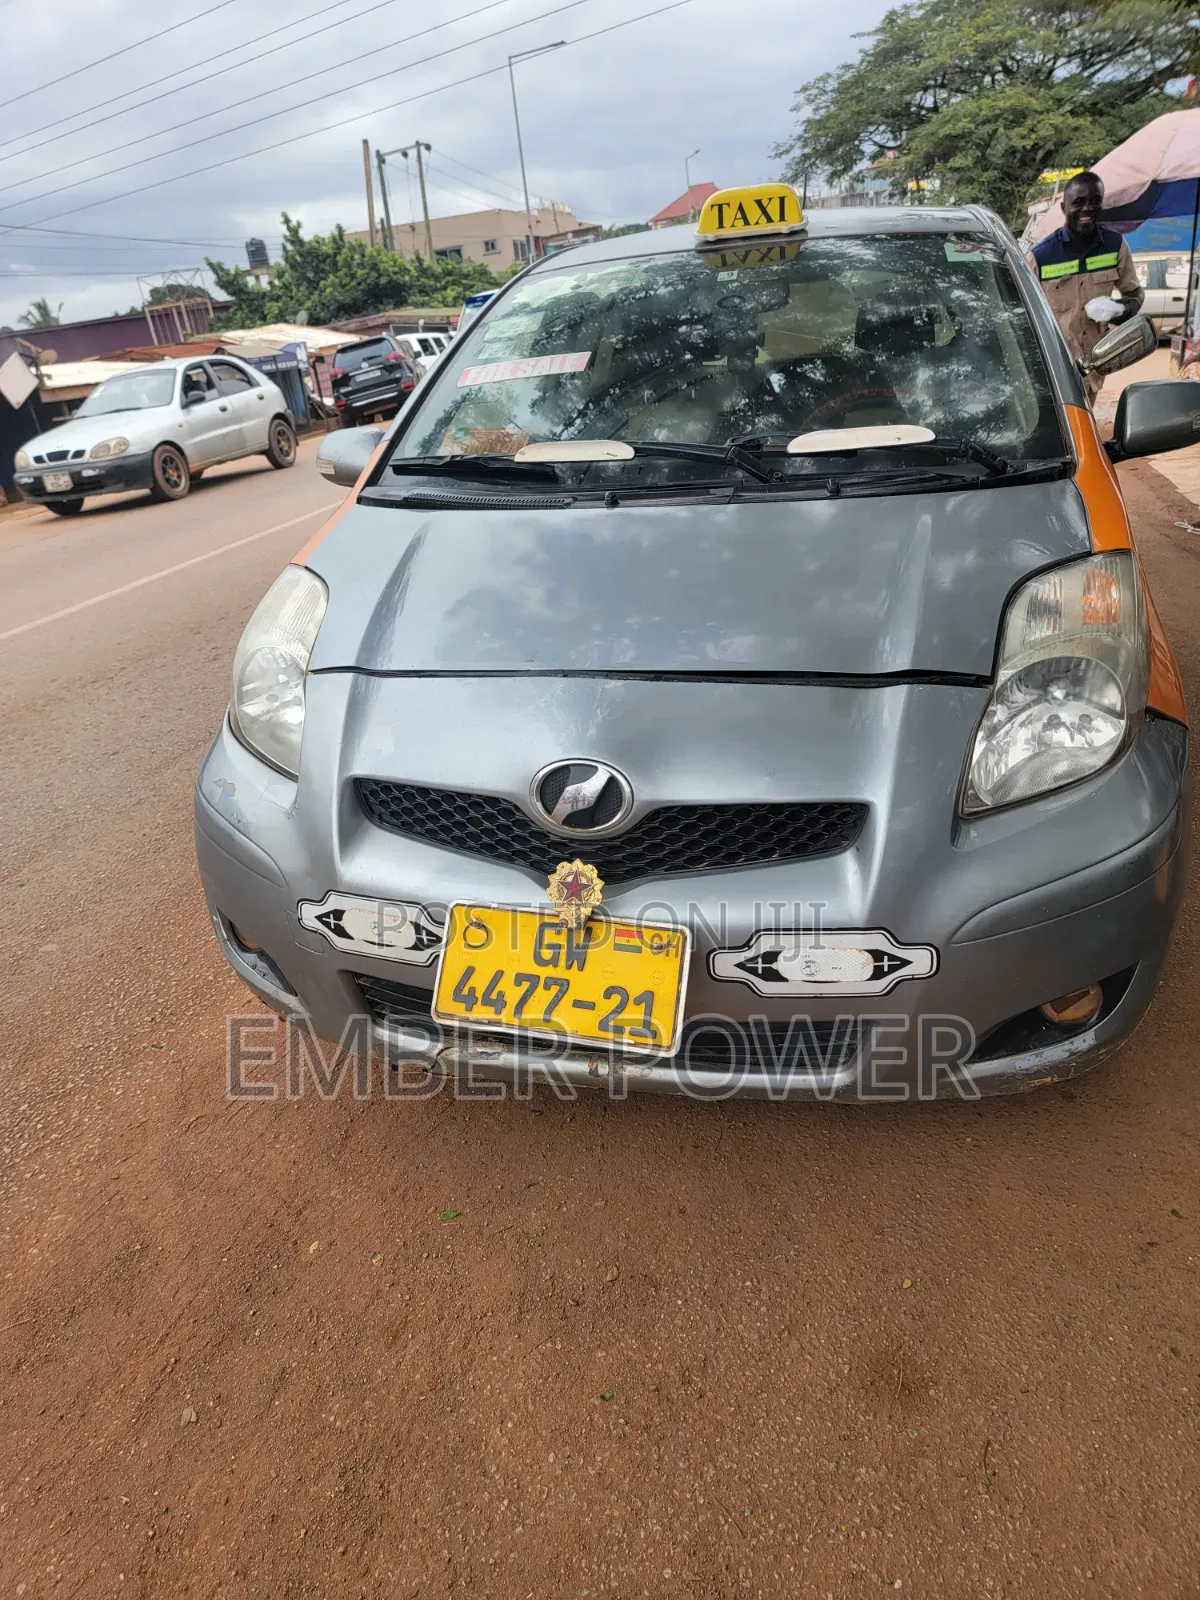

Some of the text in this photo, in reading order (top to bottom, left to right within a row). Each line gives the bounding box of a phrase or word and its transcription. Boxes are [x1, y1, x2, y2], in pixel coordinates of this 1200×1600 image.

[710, 195, 788, 230] TAXI
[465, 353, 578, 385] FOR SALE
[532, 921, 594, 972] GW
[452, 966, 657, 1039] 4477-21
